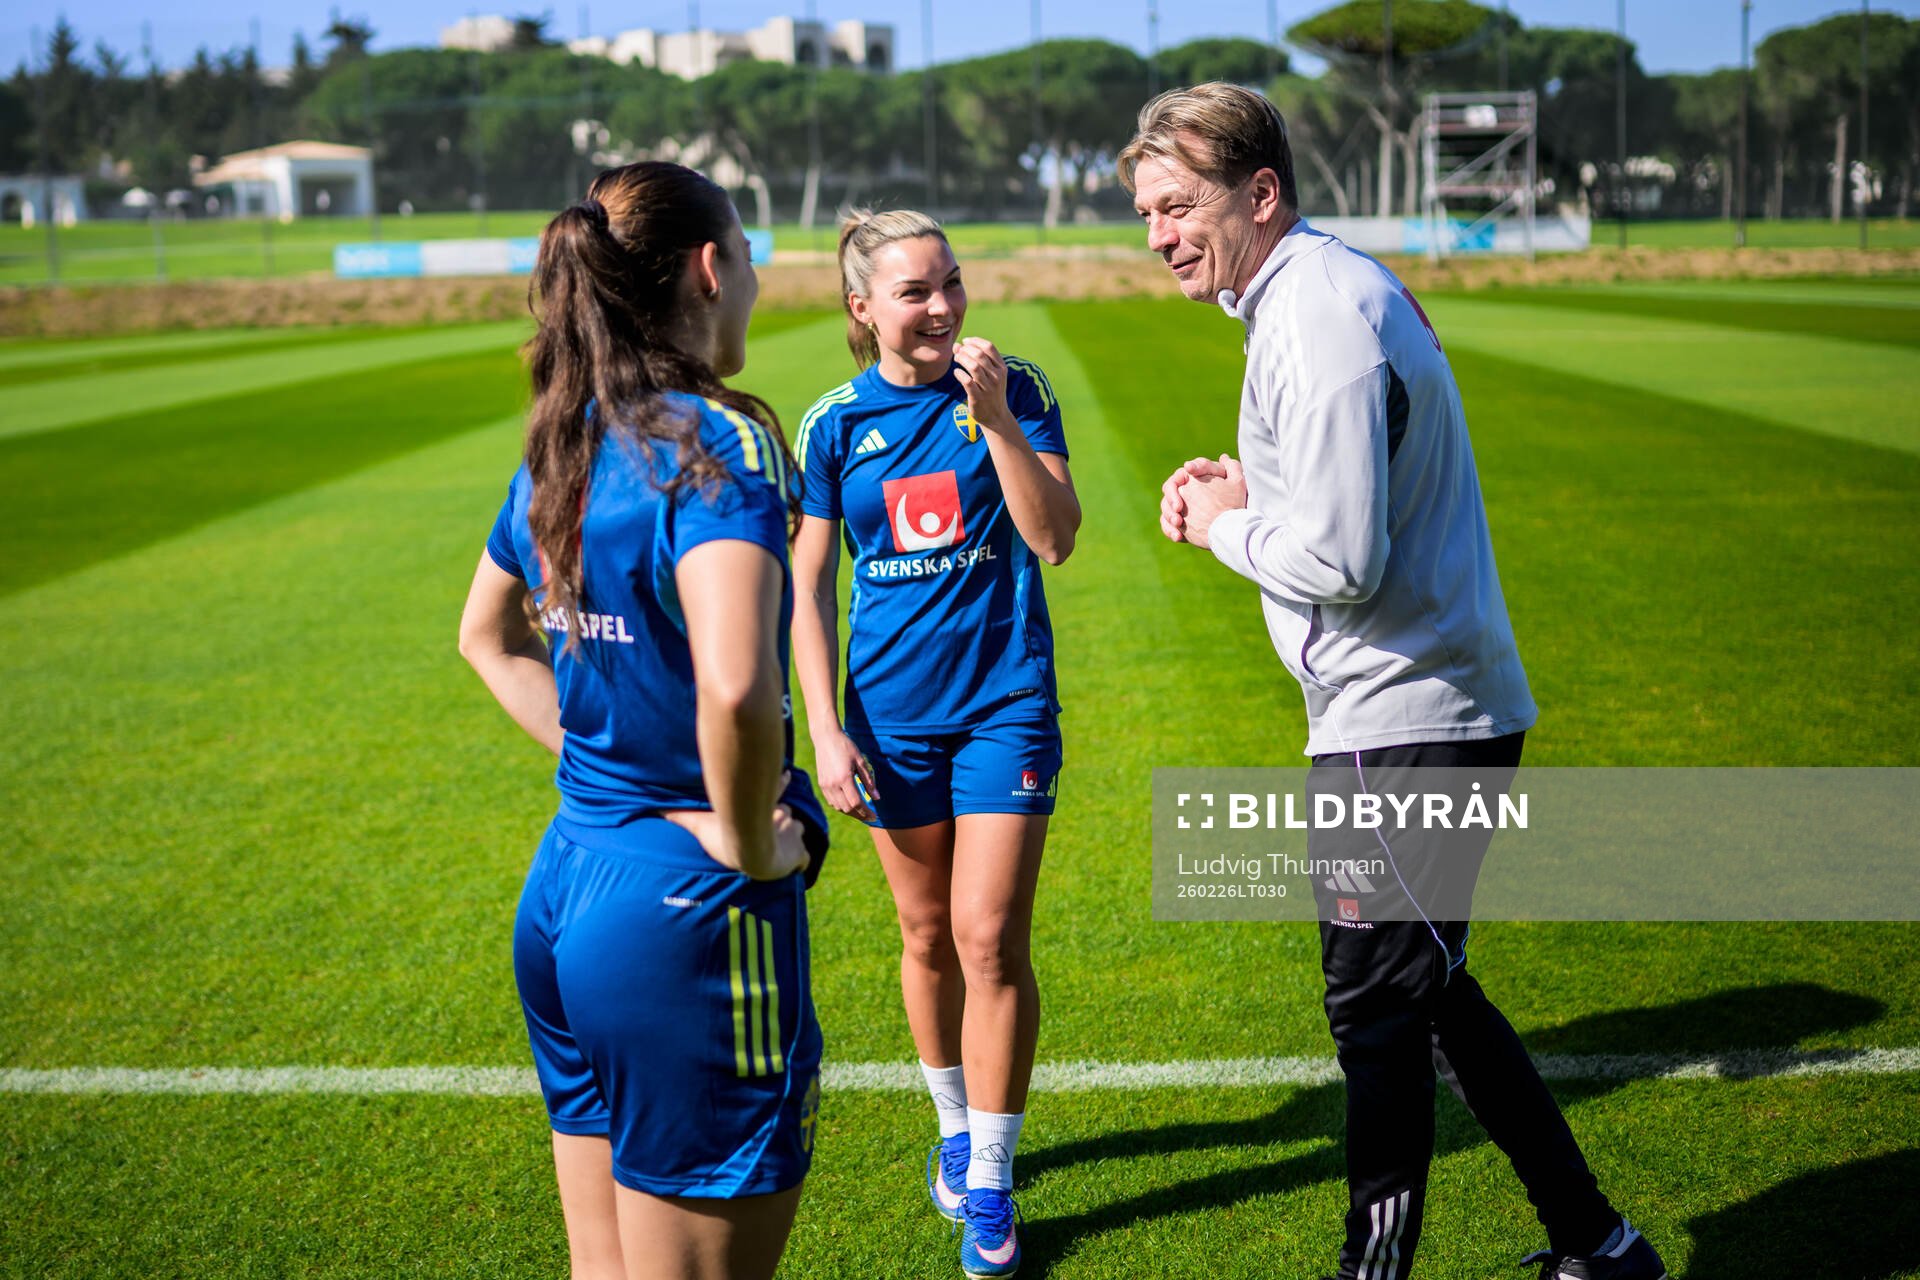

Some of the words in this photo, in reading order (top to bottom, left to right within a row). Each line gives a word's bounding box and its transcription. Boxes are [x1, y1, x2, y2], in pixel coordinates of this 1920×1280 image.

[867, 555, 953, 578] SVENSKA
[957, 544, 997, 569] SPEL
[578, 611, 635, 643] SPEL
[1330, 919, 1356, 929] SVENSKA
